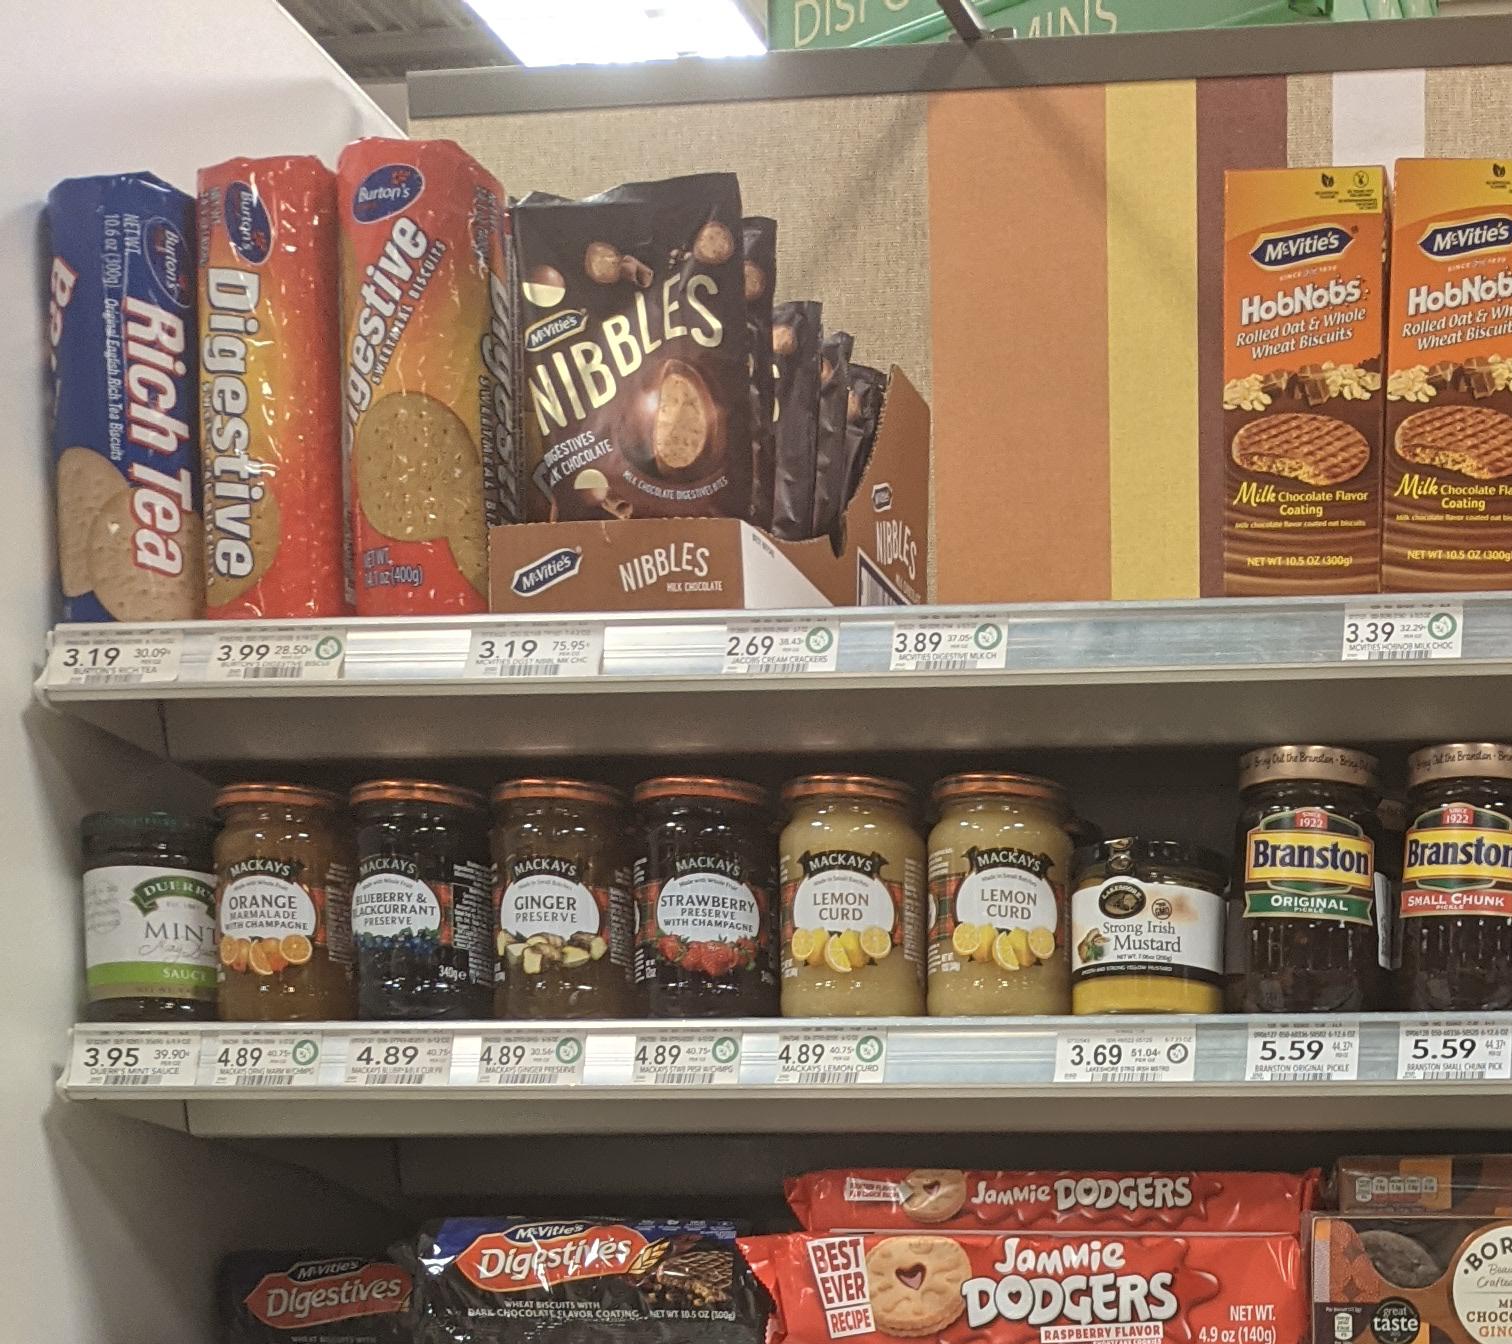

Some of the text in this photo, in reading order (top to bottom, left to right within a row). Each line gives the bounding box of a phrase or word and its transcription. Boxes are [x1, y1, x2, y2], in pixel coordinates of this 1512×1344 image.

[1265, 232, 1339, 261] McVitie's
[1241, 279, 1362, 325] HobNobs
[1236, 307, 1367, 346] Rolled Oat Whole
[527, 274, 725, 438] NIBBLES
[205, 268, 258, 580] Digestive
[128, 295, 194, 578] Rich Tea
[1233, 481, 1369, 505] Milk Chocolate Flavor
[63, 648, 120, 668] 3.19
[1299, 817, 1323, 828] 1922
[807, 854, 873, 871] MACKAYS
[1253, 839, 1370, 876] Branston
[229, 895, 297, 910] ORANGE
[514, 895, 578, 911] GINGER
[660, 895, 756, 913] STRAWBERRY
[813, 893, 870, 907] LEMON
[1270, 895, 1349, 911] ORIGINAL
[1407, 892, 1505, 908] SMALL CHUNK
[516, 913, 577, 923] PRESERVE
[819, 907, 863, 922] CURD
[1102, 921, 1175, 938] Strong Irish
[1113, 934, 1181, 953] Mustard
[84, 1049, 139, 1067] 3.95
[813, 1239, 860, 1274] BEST
[820, 1274, 866, 1305] EVER
[961, 1273, 1178, 1327] DODGERS
[831, 1309, 871, 1334] RECIPE
[1230, 1305, 1275, 1321] NET WT.
[1044, 1325, 1161, 1341] RASPBERRY FLAVOR
